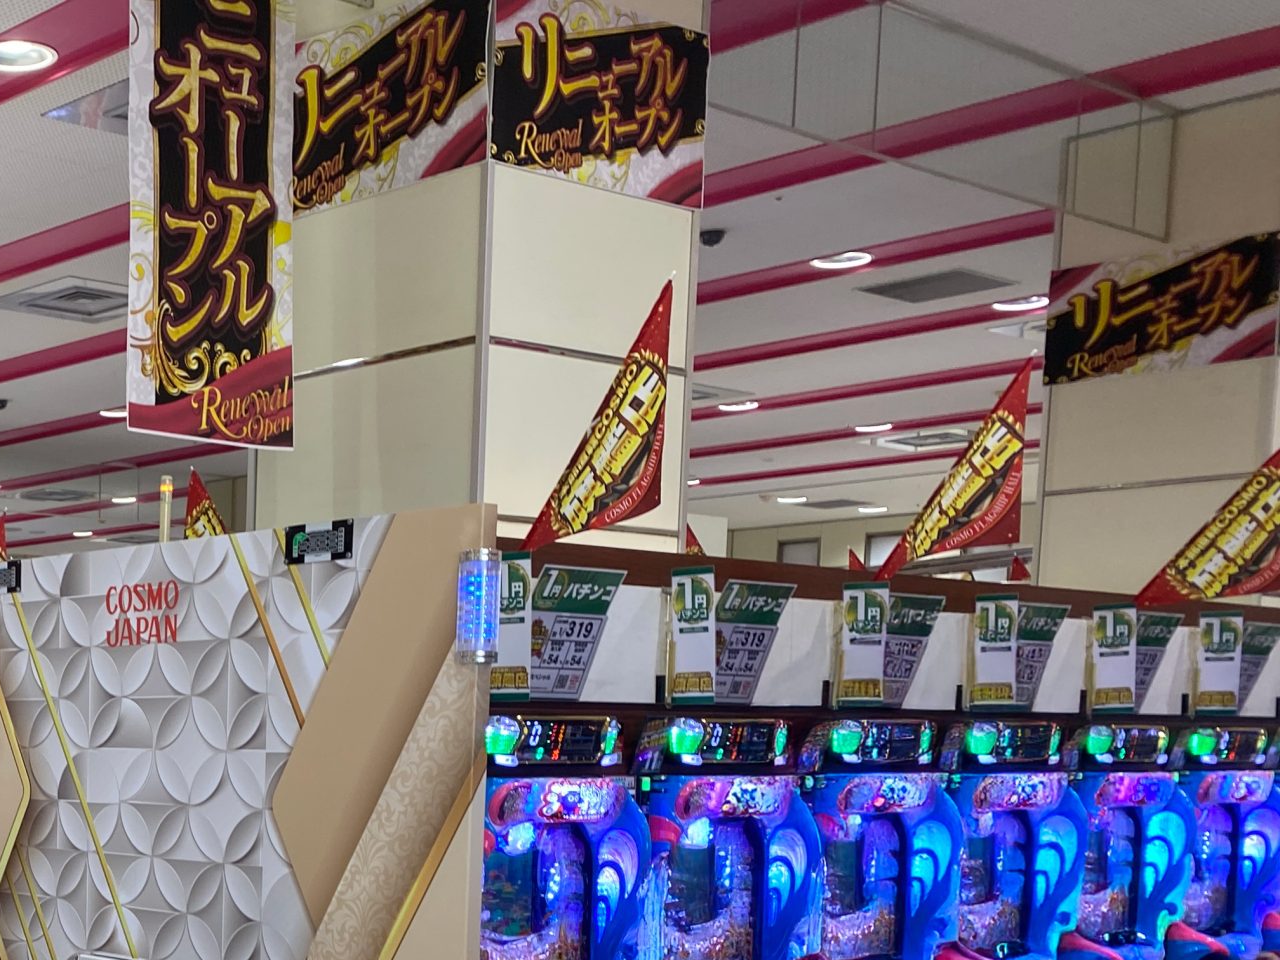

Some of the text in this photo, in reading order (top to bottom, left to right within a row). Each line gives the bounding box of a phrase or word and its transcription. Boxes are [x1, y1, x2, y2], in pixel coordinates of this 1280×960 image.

[517, 14, 687, 118] リニューアル
[354, 66, 458, 163] オープン
[590, 100, 681, 151] オープン
[515, 119, 583, 168] Renewal
[156, 43, 221, 342] オープン
[1069, 251, 1259, 349] リニューアル
[1146, 291, 1252, 349] オープン
[192, 376, 291, 440] Renewal
[105, 579, 180, 615] COSMO
[564, 582, 618, 601] パチンコ
[677, 579, 706, 609] 1円
[742, 596, 788, 611] パチンコ
[106, 614, 178, 648] JAPAN
[1099, 610, 1128, 637] 1円
[1205, 618, 1235, 643] 1円
